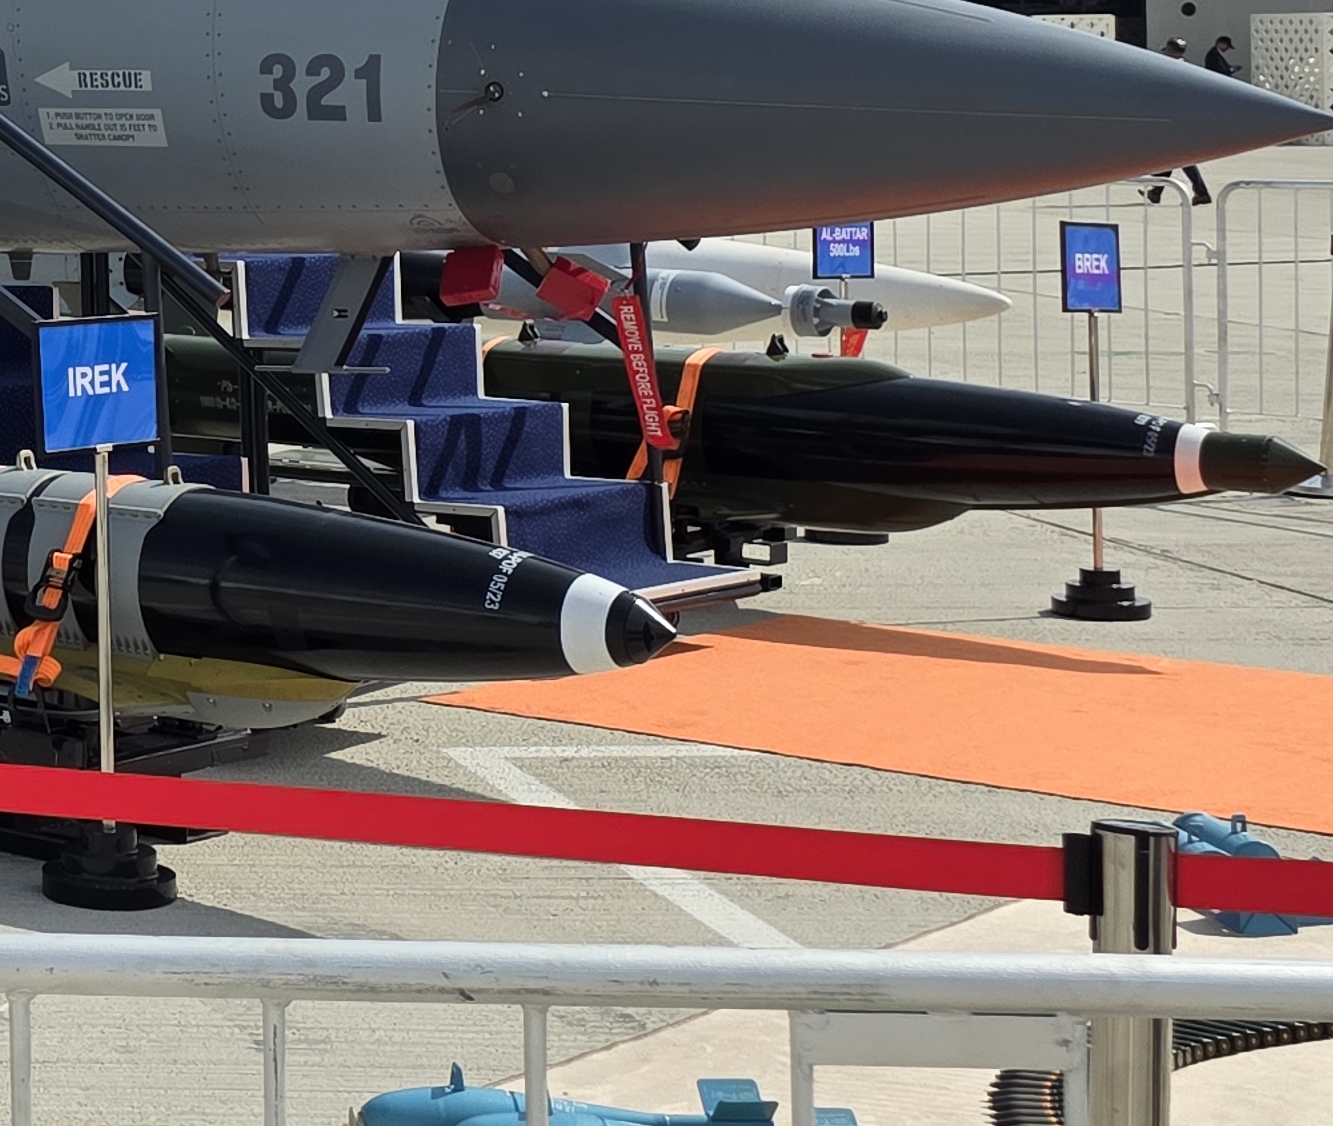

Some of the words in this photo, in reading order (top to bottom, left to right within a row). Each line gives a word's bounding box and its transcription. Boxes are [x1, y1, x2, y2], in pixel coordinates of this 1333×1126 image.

[77, 71, 144, 90] RESCUE
[259, 52, 383, 123] 321
[820, 227, 868, 241] AL-BATTAR
[829, 242, 860, 258] 500Lbs
[1074, 253, 1110, 274] BREK
[618, 305, 643, 351] REMOVE
[67, 362, 130, 398] IREK
[630, 353, 649, 397] BEFORE
[640, 397, 663, 437] FLIGHT
[484, 574, 509, 610] 05/23
